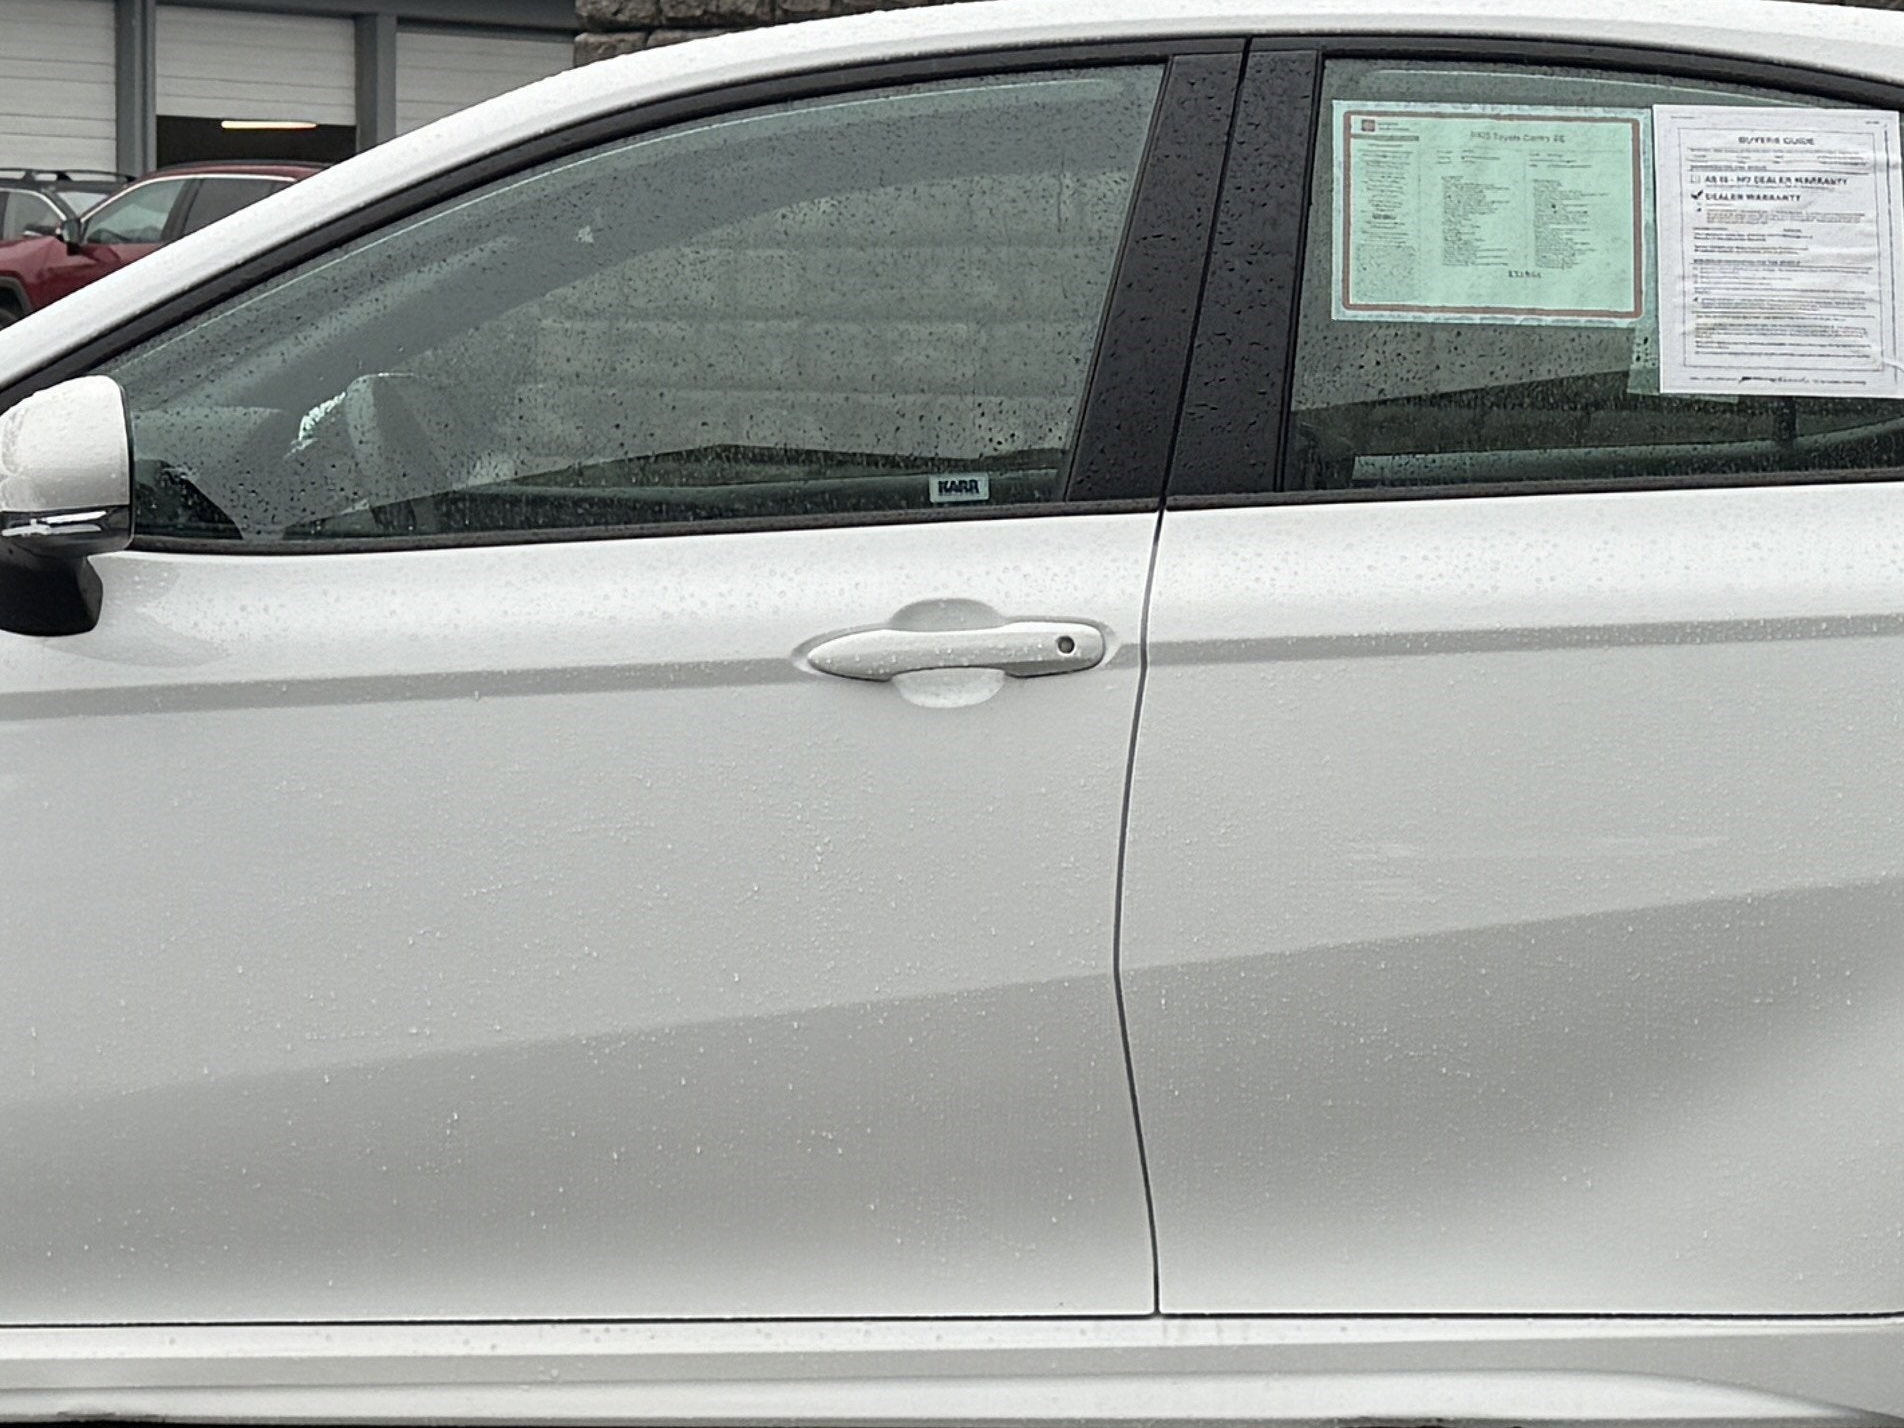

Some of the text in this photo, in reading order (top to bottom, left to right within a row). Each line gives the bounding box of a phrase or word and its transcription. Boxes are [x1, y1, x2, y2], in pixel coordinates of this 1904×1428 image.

[1753, 176, 1792, 185] DEALER
[1794, 176, 1849, 186] WARRANTY
[1705, 193, 1802, 202] DEALER WARRANTY
[937, 479, 980, 494] KARR
